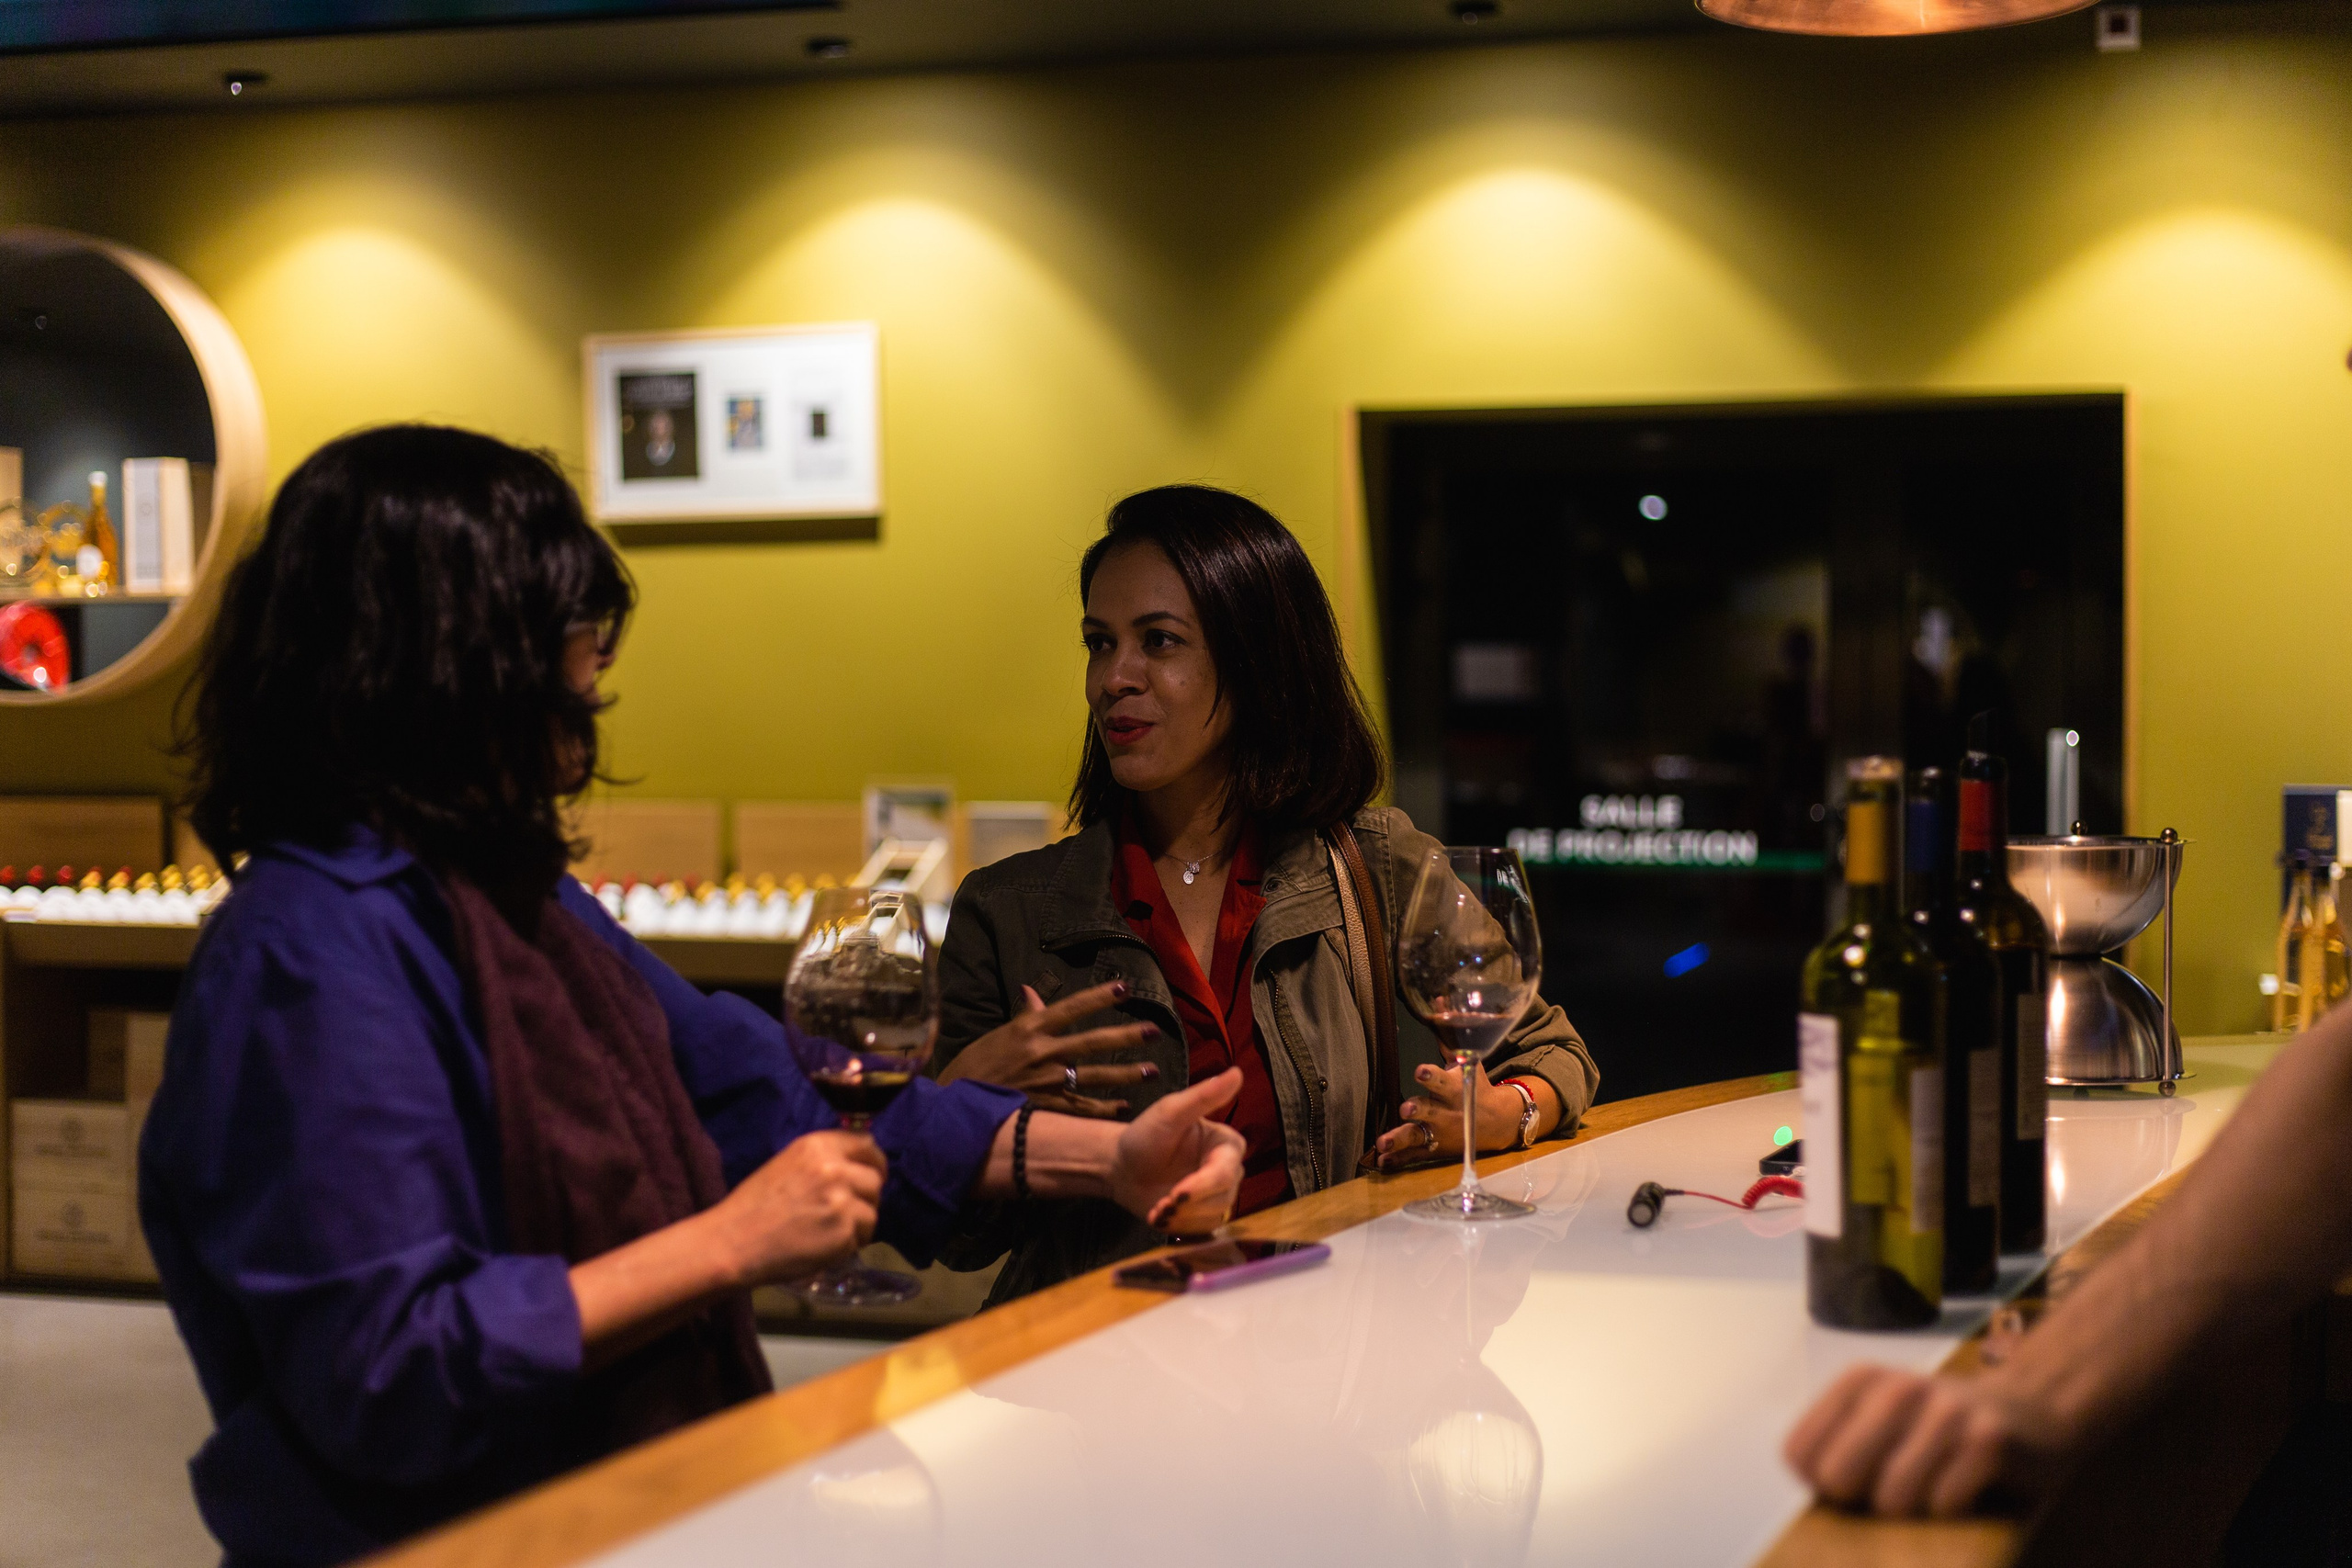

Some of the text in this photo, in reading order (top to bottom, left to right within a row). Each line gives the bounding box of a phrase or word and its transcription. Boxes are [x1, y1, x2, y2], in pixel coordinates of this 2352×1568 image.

[1580, 794, 1684, 828] SALLE
[1507, 828, 1758, 866] DE PROJECTION
